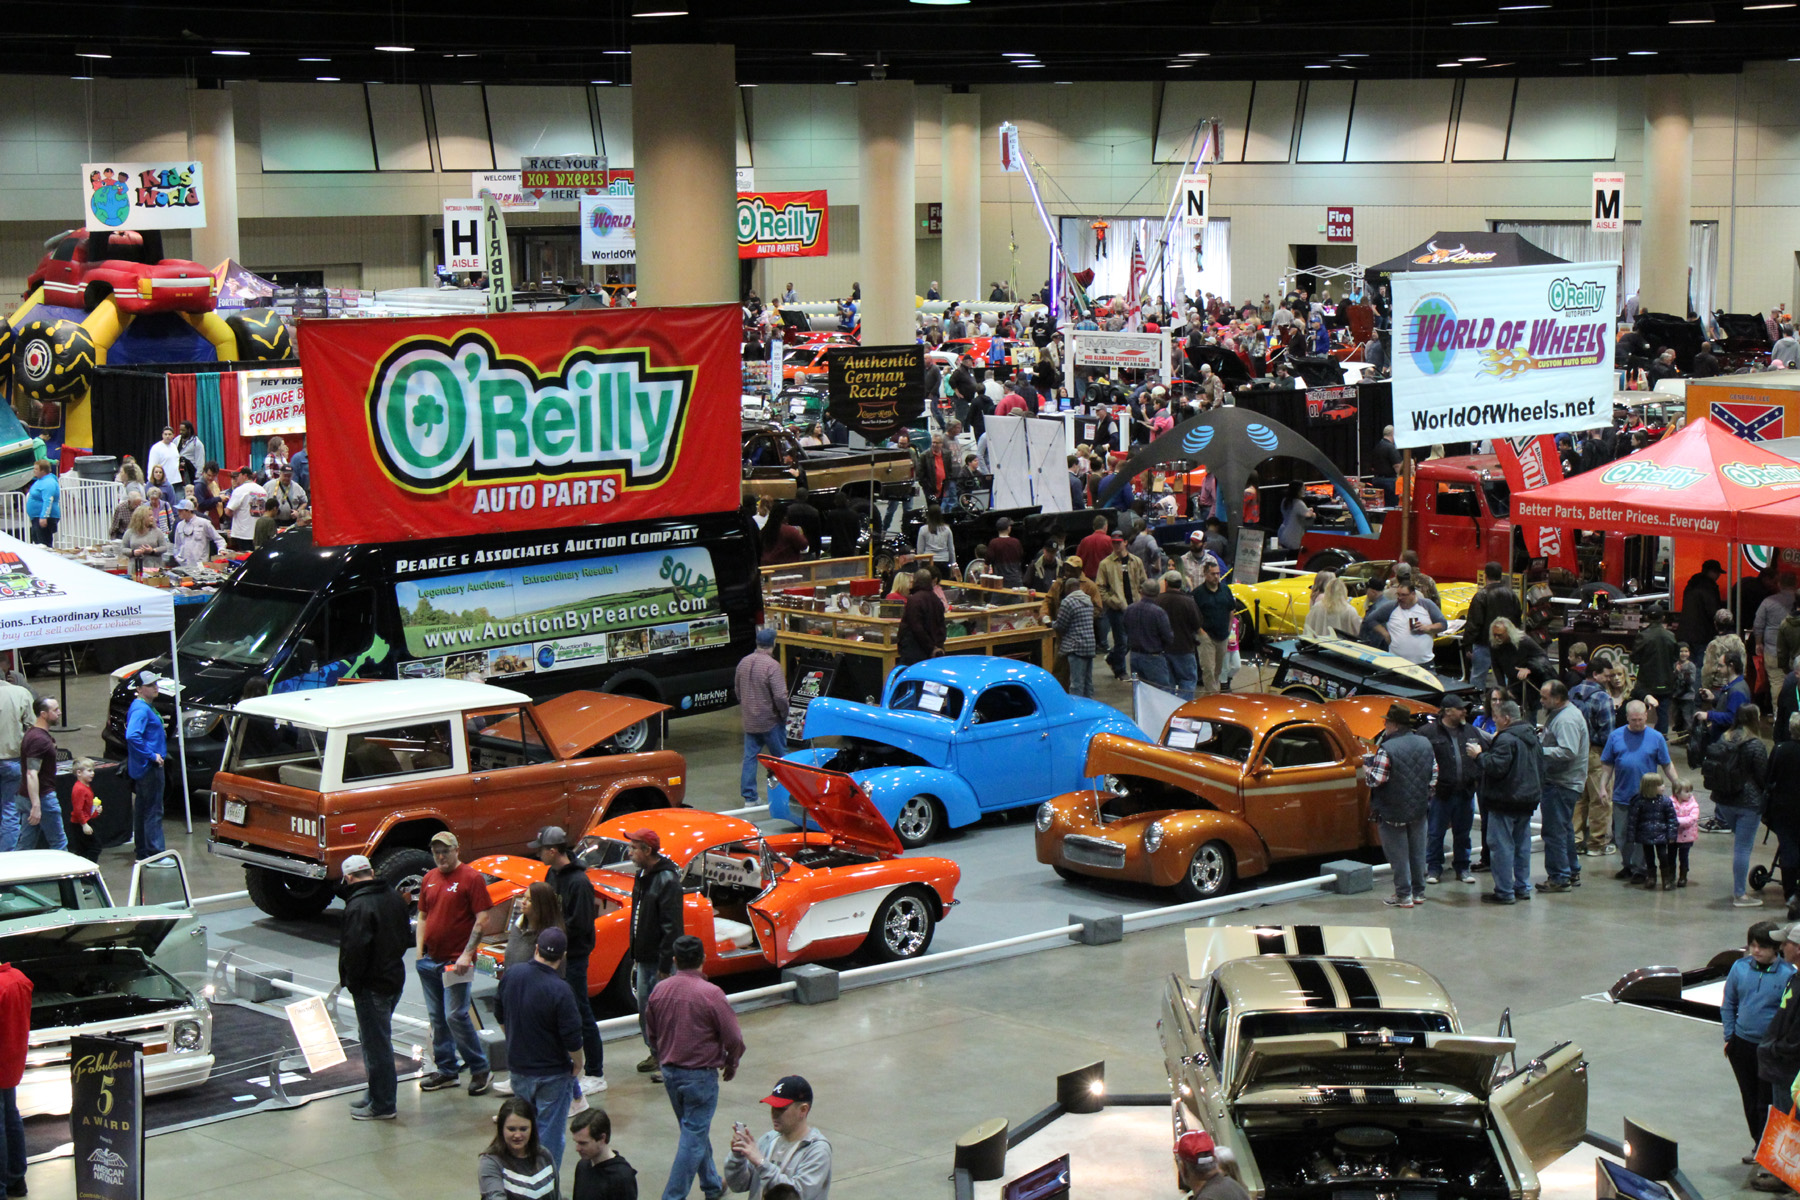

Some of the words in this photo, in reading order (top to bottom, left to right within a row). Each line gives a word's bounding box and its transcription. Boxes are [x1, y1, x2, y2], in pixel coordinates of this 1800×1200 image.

[530, 160, 560, 169] RACE
[566, 160, 598, 169] YOUR
[135, 187, 200, 208] World
[551, 190, 580, 199] HERE
[1188, 190, 1204, 216] N
[1595, 190, 1620, 219] M
[593, 212, 632, 228] WORLD
[737, 203, 817, 240] O'Reilly
[1328, 211, 1351, 222] Fire
[452, 220, 478, 256] H
[1328, 225, 1352, 237] Exit
[592, 250, 636, 259] WorldOfW
[757, 245, 776, 253] AUTO
[777, 244, 800, 252] PARTS
[452, 258, 479, 268] AISLE
[1551, 281, 1602, 308] O'Reilly
[1084, 338, 1150, 350] MACC
[1414, 314, 1494, 353] WORLD
[1496, 320, 1526, 350] OF
[1528, 318, 1607, 358] WHEELS
[1538, 359, 1562, 368] CUSTOM
[1564, 358, 1578, 366] AUTO
[1580, 356, 1598, 365] SHOW
[844, 371, 904, 384] German
[252, 390, 294, 410] SPONGE
[298, 388, 304, 398] B
[1308, 390, 1341, 402] GENERAL
[1342, 388, 1356, 398] LEE
[249, 408, 290, 425] SQUARE
[292, 405, 305, 418] PA
[386, 352, 674, 470] O'Reilly
[1308, 404, 1320, 418] 01
[1412, 397, 1596, 432] WorldOfWheels.net
[1608, 463, 1698, 488] O'Reilly
[472, 484, 536, 514] AUTO
[542, 478, 616, 508] PARTS
[1520, 502, 1552, 517] Better
[1555, 504, 1586, 520] Parts,
[1589, 506, 1623, 522] Better
[396, 556, 456, 574] PEARCE
[460, 554, 470, 565] &
[474, 543, 560, 564] ASSOCIATES
[564, 535, 626, 552] AUCTION
[630, 528, 700, 545] COMPANY
[418, 585, 465, 599] Legendary
[523, 568, 580, 585] Extraordinary
[582, 565, 614, 578] Results
[660, 555, 708, 598] SOLD
[102, 605, 142, 618] Results!
[2, 630, 20, 640] buy
[24, 628, 42, 638] and
[45, 626, 62, 635] sell
[64, 622, 102, 633] collector
[105, 618, 142, 629] vehicles
[424, 597, 707, 648] www.AuctionByPearce.com
[694, 689, 728, 702] MarkNet
[694, 698, 728, 708] ALLIANCE
[290, 816, 316, 837] FORD
[73, 1050, 132, 1083] Fabulous
[97, 1076, 116, 1116] 5
[82, 1116, 130, 1131] AWARD
[92, 1164, 124, 1178] AMERICAN
[94, 1171, 124, 1186] NATIONAL
